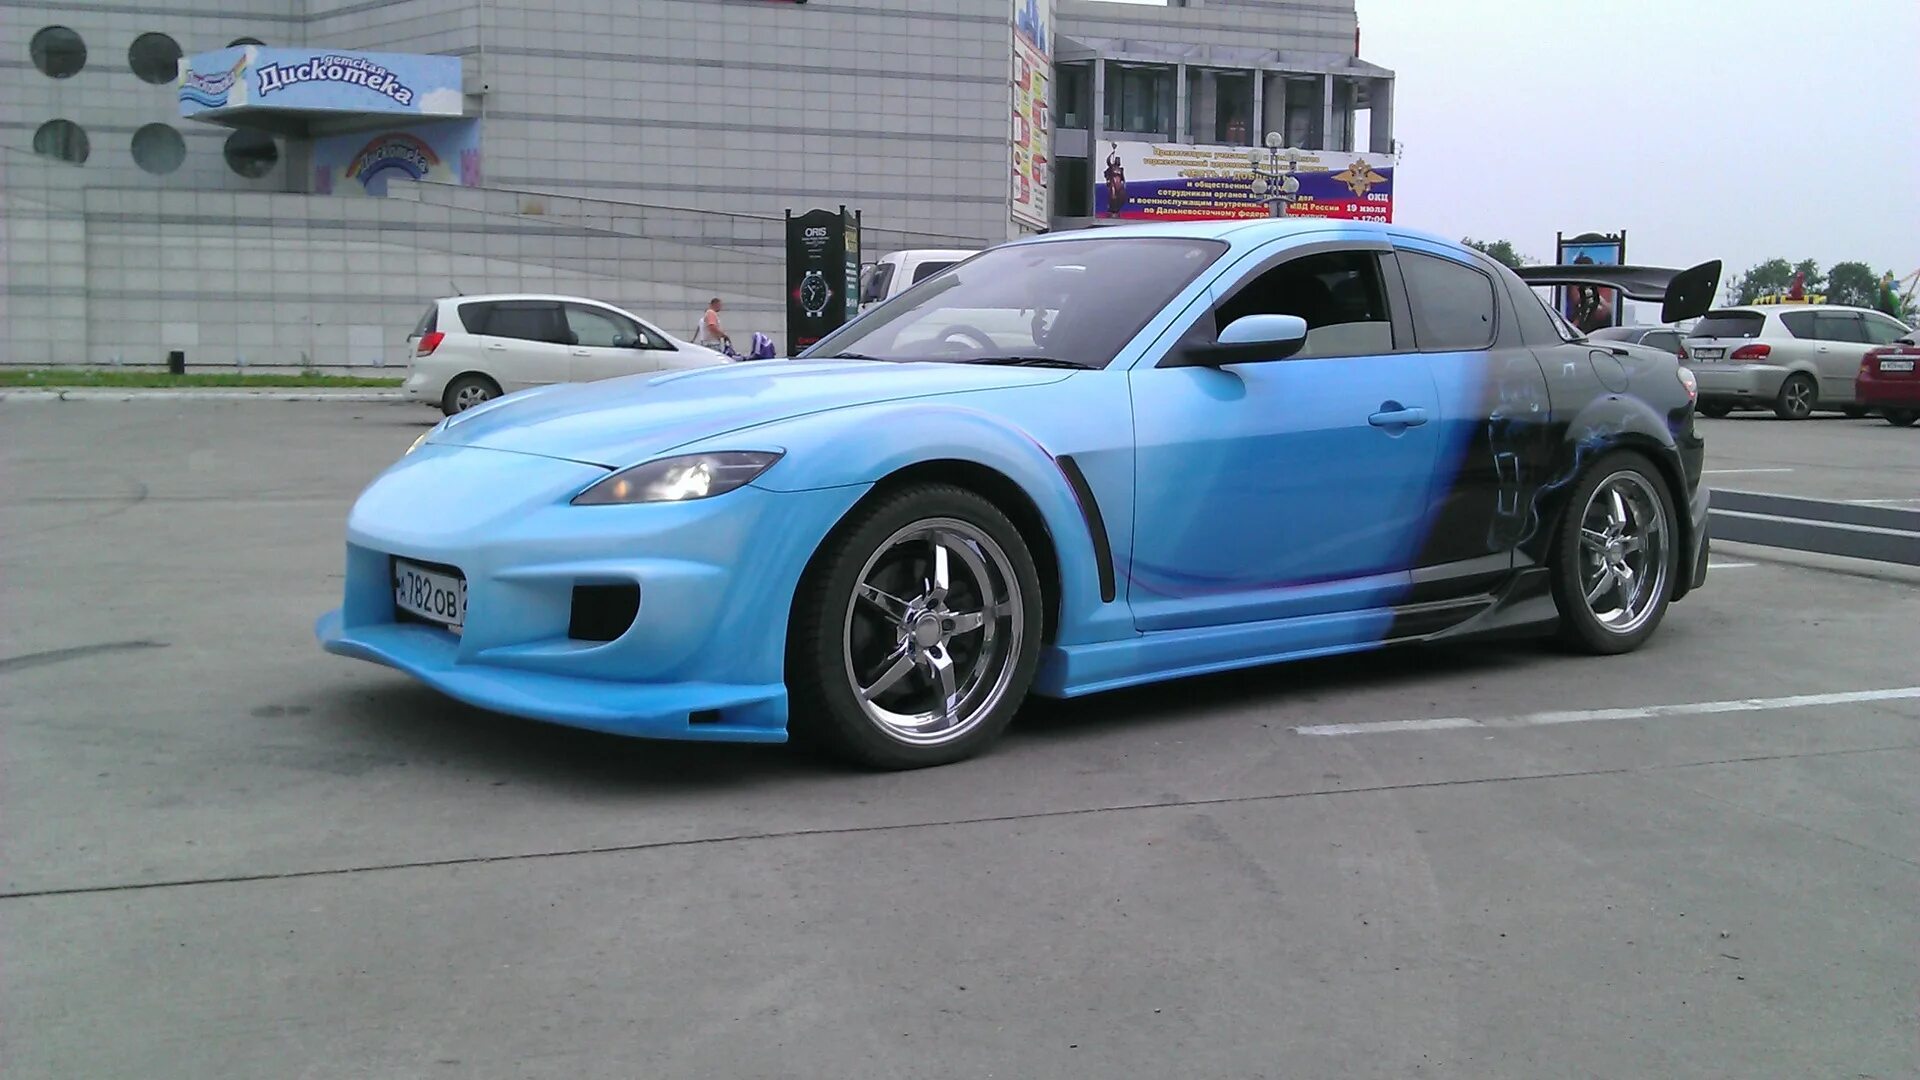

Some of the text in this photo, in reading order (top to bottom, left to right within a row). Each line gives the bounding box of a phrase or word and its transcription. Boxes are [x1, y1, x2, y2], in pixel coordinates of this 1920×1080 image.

[323, 55, 386, 74] детская
[257, 58, 413, 106] Дискотека
[1195, 181, 1251, 190] общественны
[1157, 189, 1212, 198] сотрудникам
[1213, 191, 1247, 199] органов
[1367, 193, 1388, 203] ОКЦ
[1137, 198, 1212, 207] военнослужащим
[1310, 203, 1339, 211] России
[1347, 204, 1386, 213] 19 июля
[1156, 206, 1236, 217] Дальневосточному
[805, 227, 827, 237] ORIS
